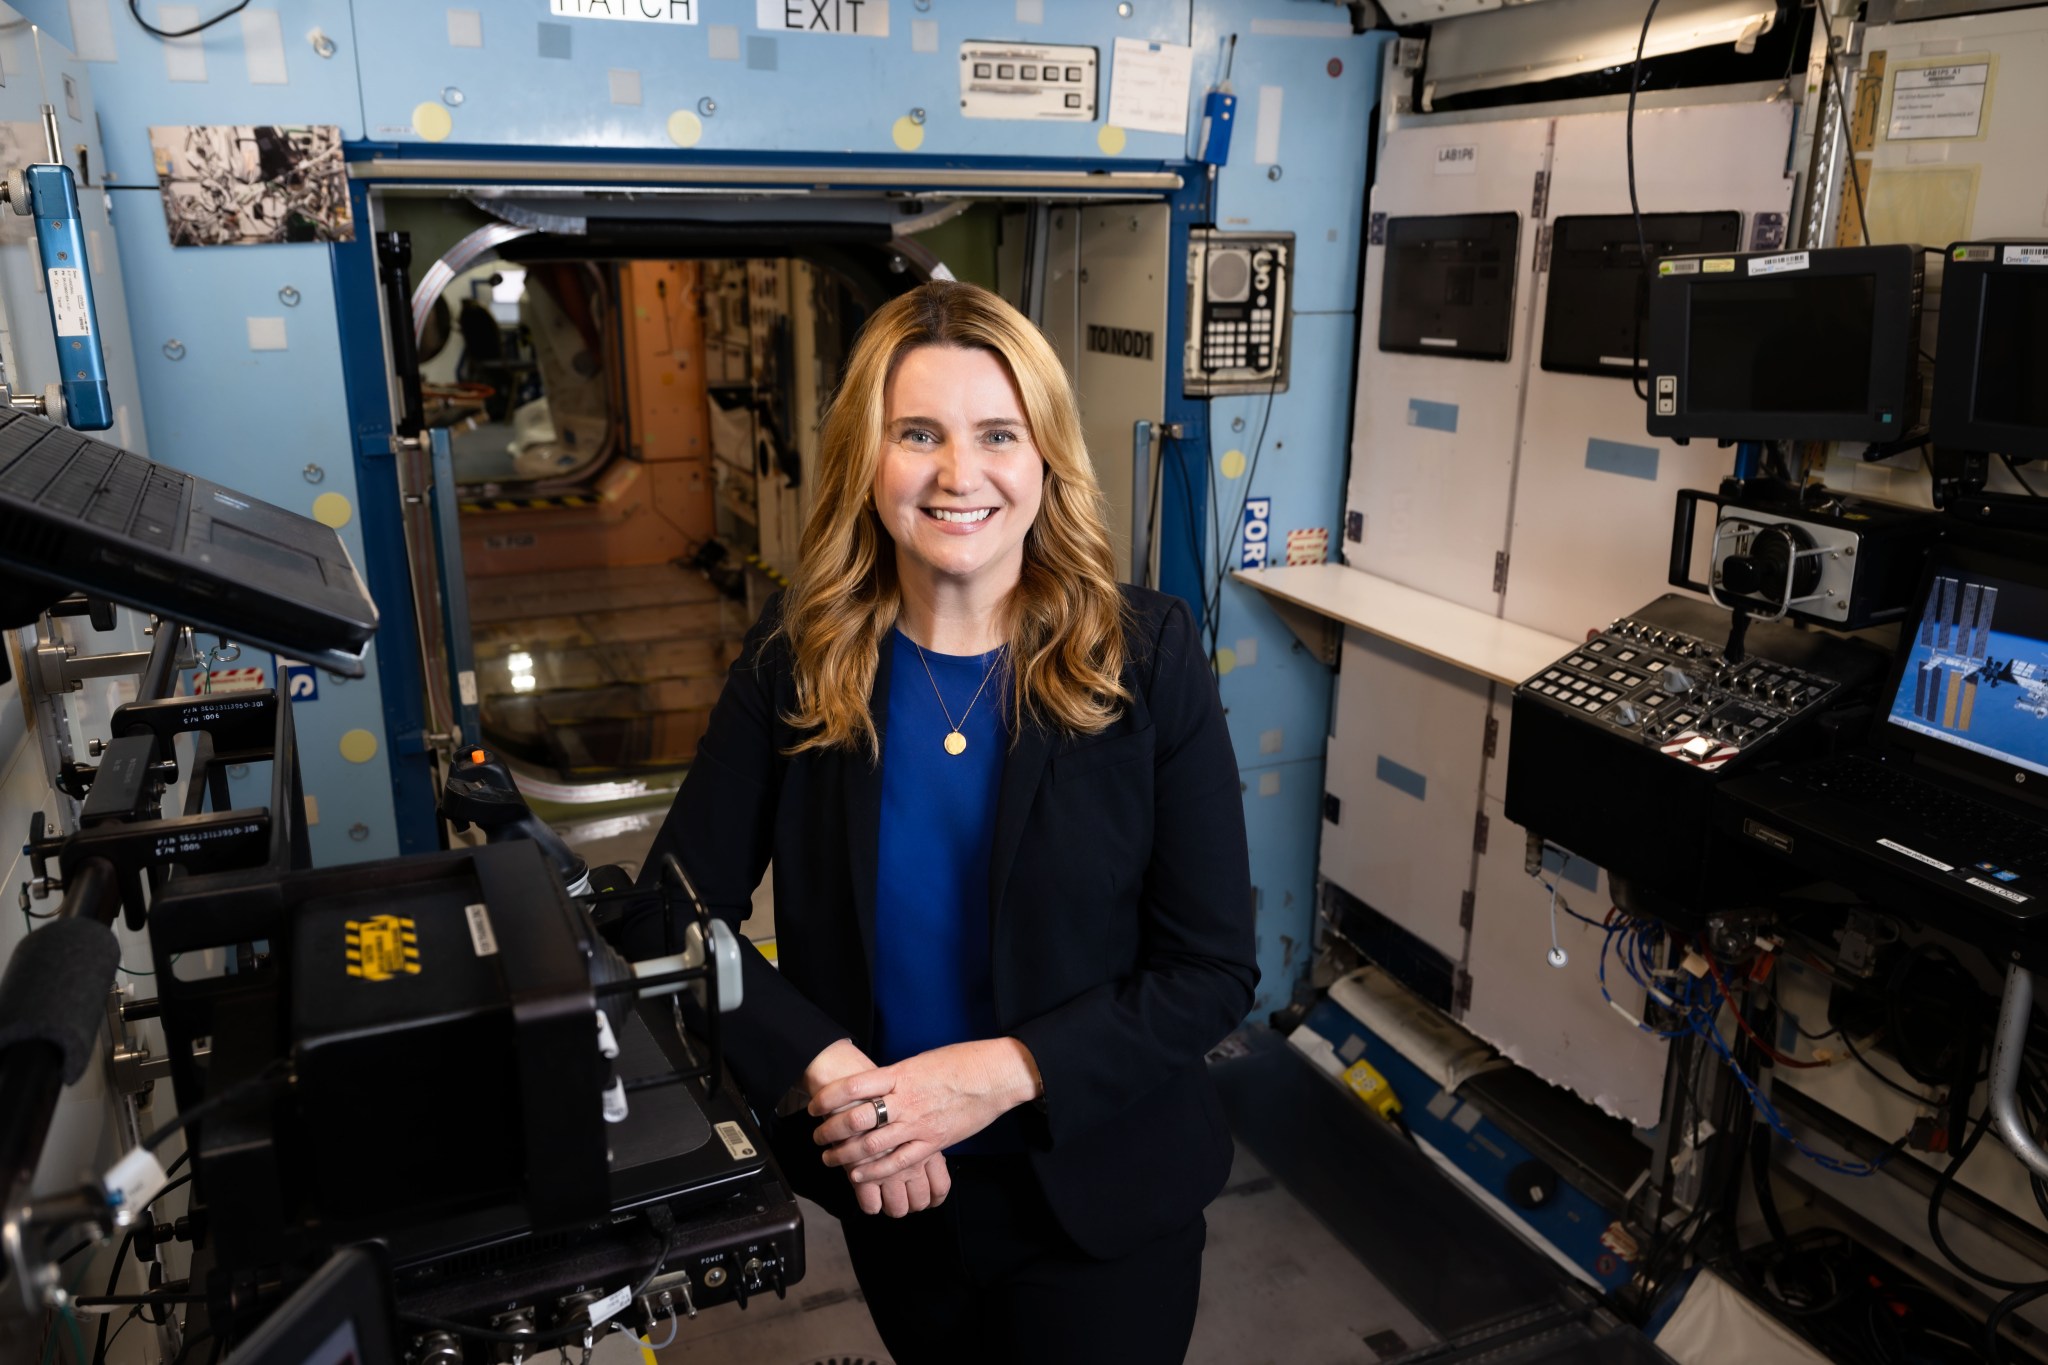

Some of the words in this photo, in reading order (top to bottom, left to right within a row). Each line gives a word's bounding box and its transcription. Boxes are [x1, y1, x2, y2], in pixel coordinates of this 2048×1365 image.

[785, 0, 865, 33] EXIT
[1438, 148, 1474, 162] LAB1P6
[1089, 325, 1108, 353] TO
[1111, 328, 1152, 360] NOD1
[1243, 500, 1269, 570] POR
[701, 1253, 724, 1264] POWER
[749, 1245, 758, 1253] ON
